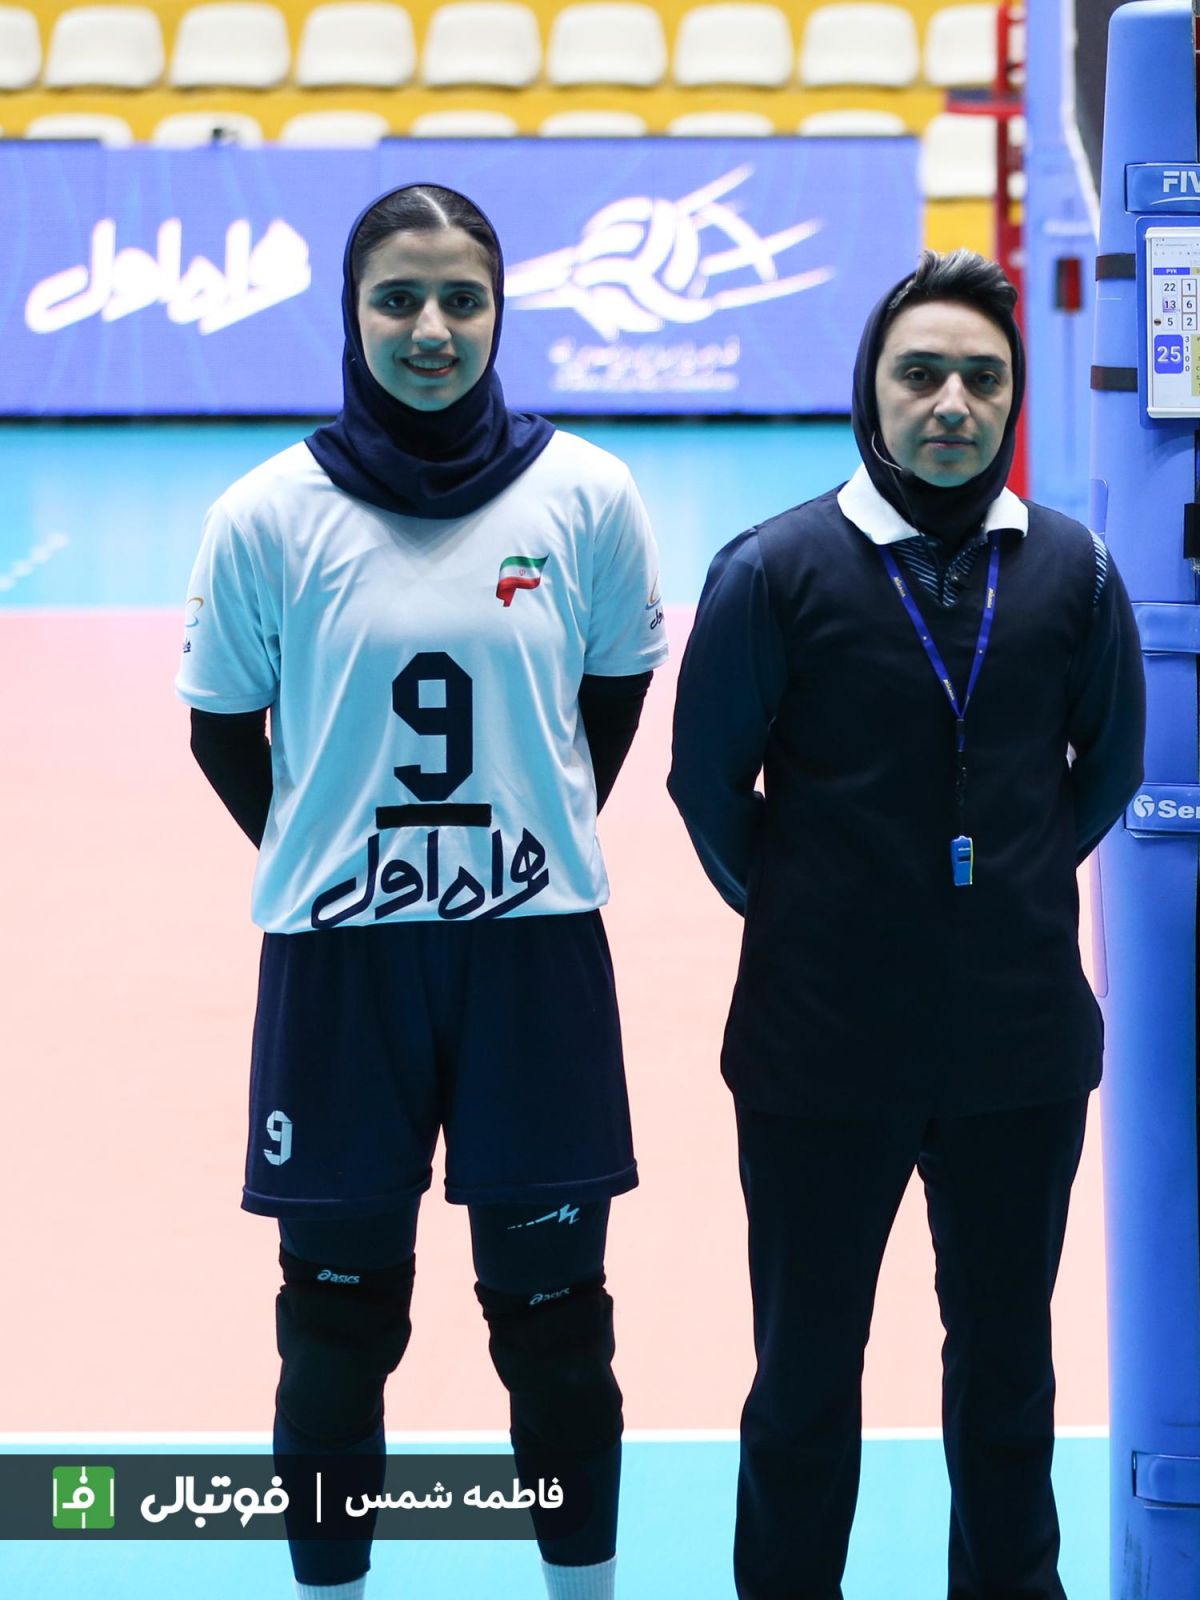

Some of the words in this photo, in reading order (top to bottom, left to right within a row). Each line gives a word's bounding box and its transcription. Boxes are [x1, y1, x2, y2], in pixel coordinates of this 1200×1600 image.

[1163, 283, 1176, 292] 22
[1186, 283, 1191, 291] 1
[1164, 300, 1176, 309] 13
[1186, 300, 1193, 309] 6
[1167, 317, 1174, 326] 5
[1186, 317, 1193, 326] 2
[1157, 345, 1181, 363] 25
[392, 651, 474, 802] 9
[263, 1110, 294, 1166] 9
